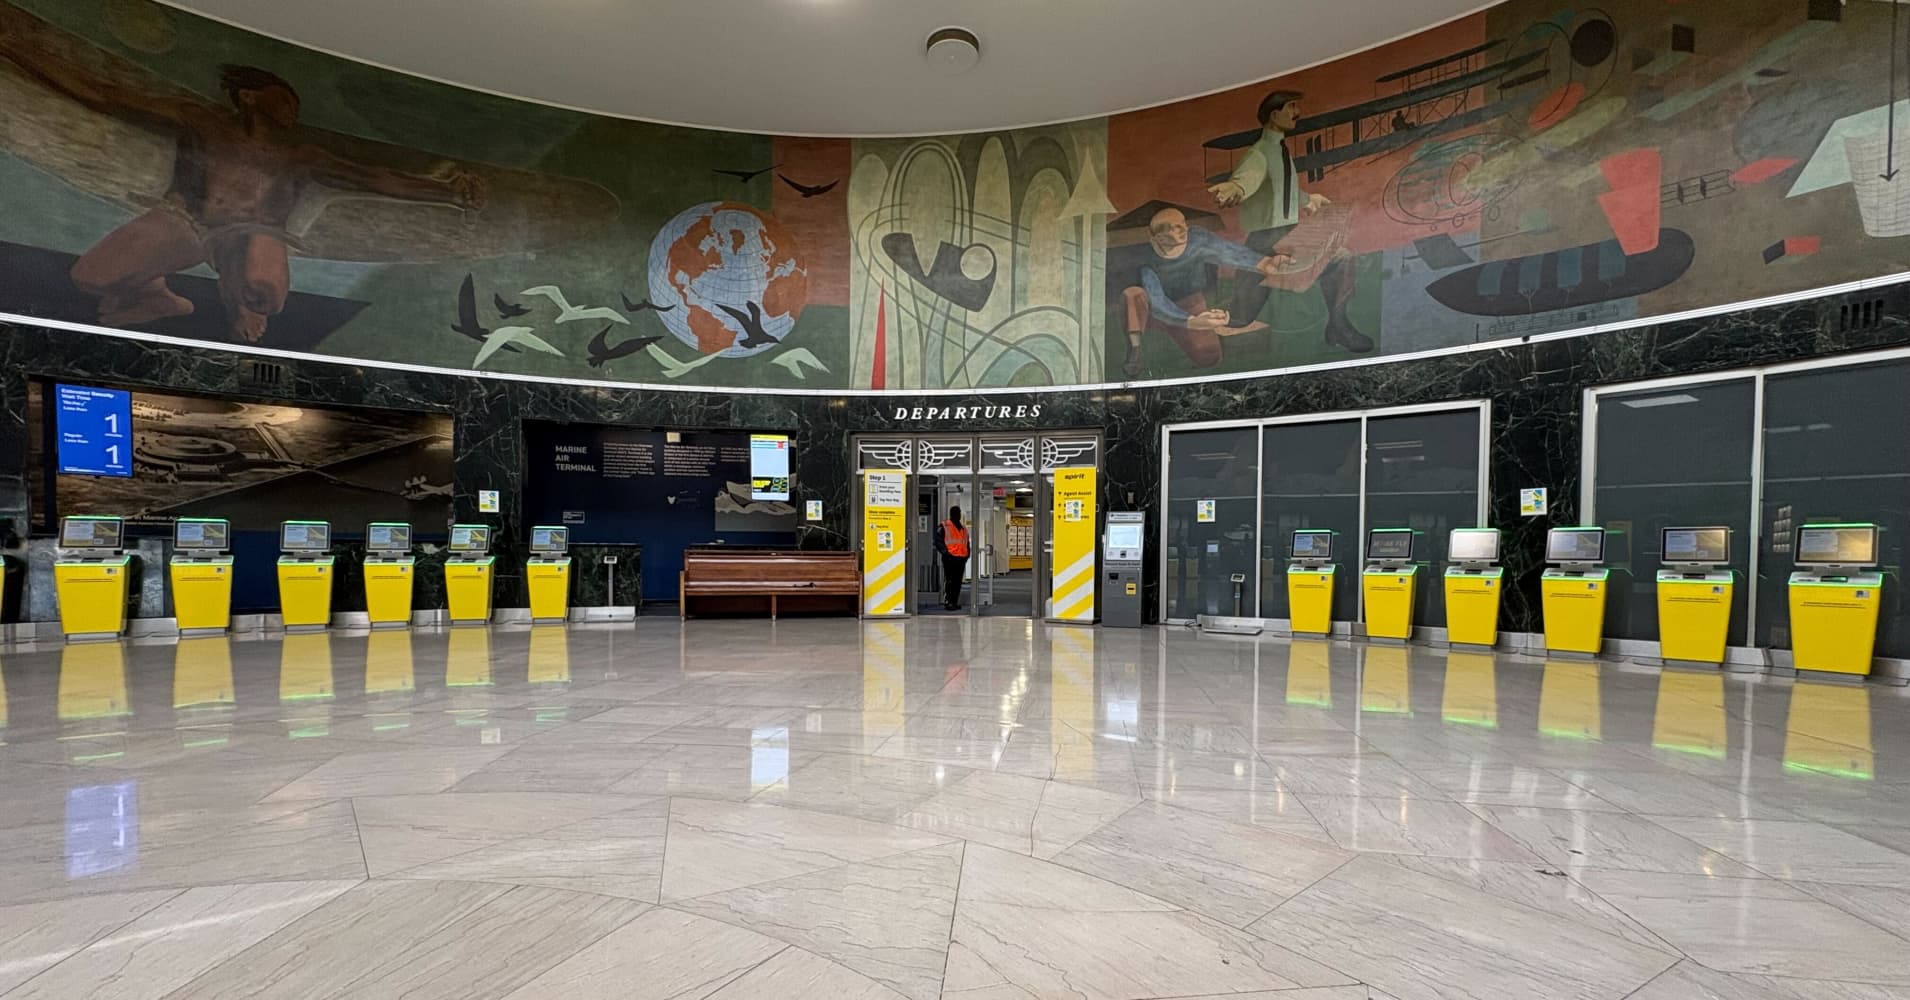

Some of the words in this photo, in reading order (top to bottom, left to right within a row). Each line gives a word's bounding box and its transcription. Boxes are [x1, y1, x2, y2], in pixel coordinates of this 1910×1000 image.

[894, 404, 1041, 420] DEPARTURES
[104, 413, 118, 434] 1
[105, 445, 119, 465] 1
[555, 445, 588, 454] MARINE
[555, 454, 570, 463] AIR
[555, 463, 597, 473] TERMINAL
